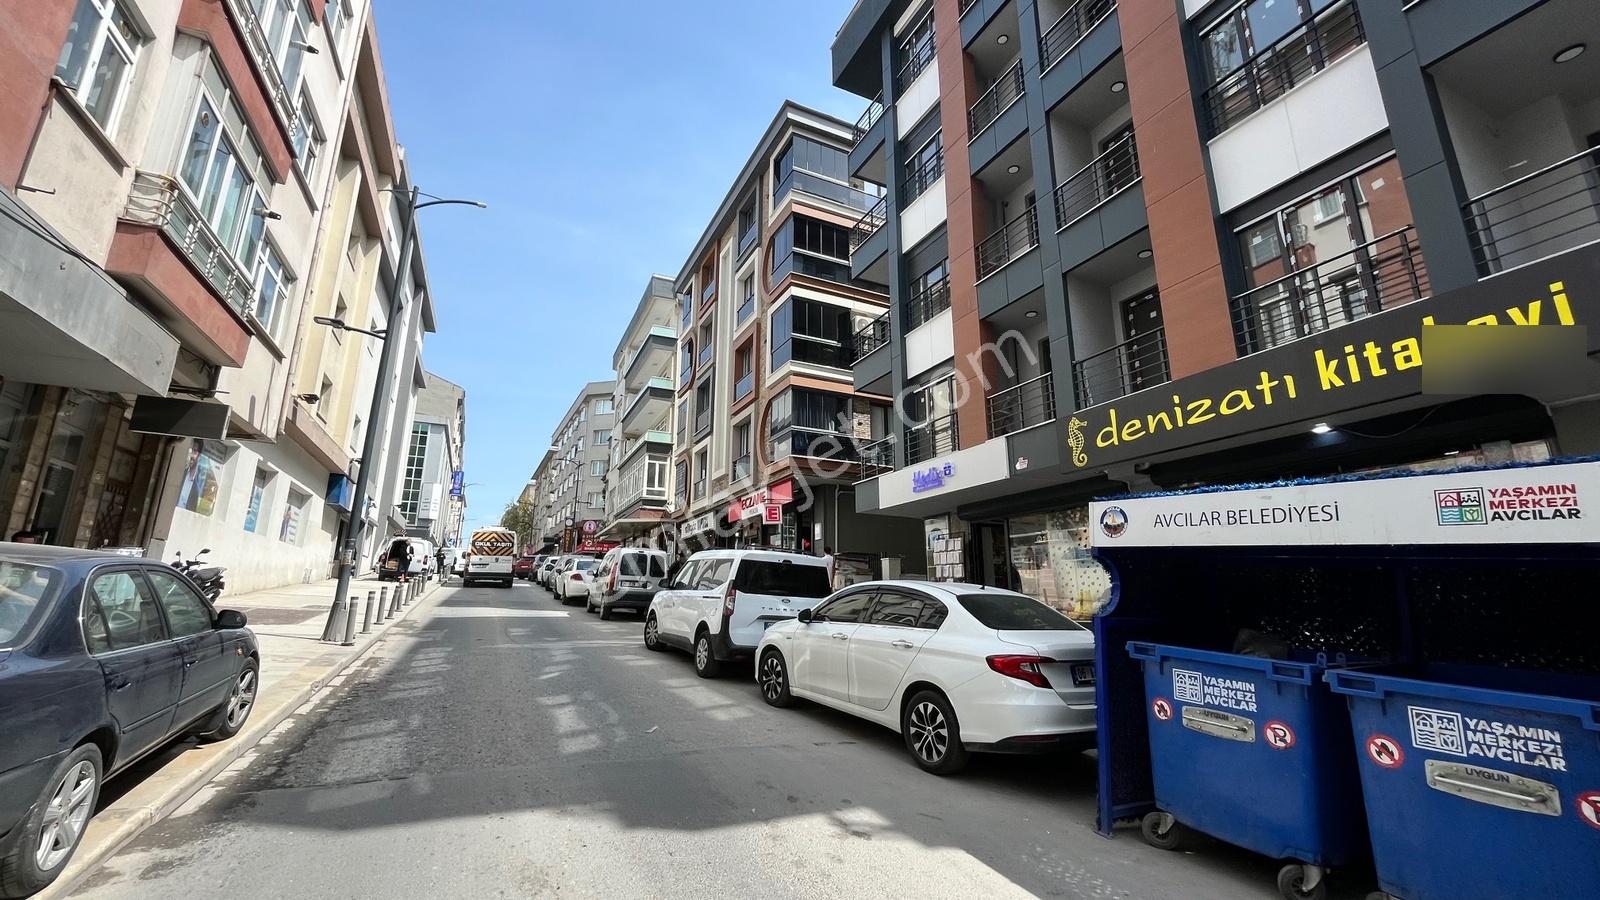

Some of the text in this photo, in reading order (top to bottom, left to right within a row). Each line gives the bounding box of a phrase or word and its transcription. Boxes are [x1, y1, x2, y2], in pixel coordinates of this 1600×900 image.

[1488, 484, 1577, 499] YAŞAMIN
[1153, 501, 1340, 528] AVCILAR BELEDİYESİ
[1490, 508, 1582, 522] AVCILAR
[1203, 675, 1256, 692] YAŞAMIN
[1204, 694, 1258, 713] AVCILAR
[1464, 717, 1562, 743] YAŞAMIN
[1468, 743, 1568, 772] AVCILAR
[1464, 767, 1510, 784] UYGUN
